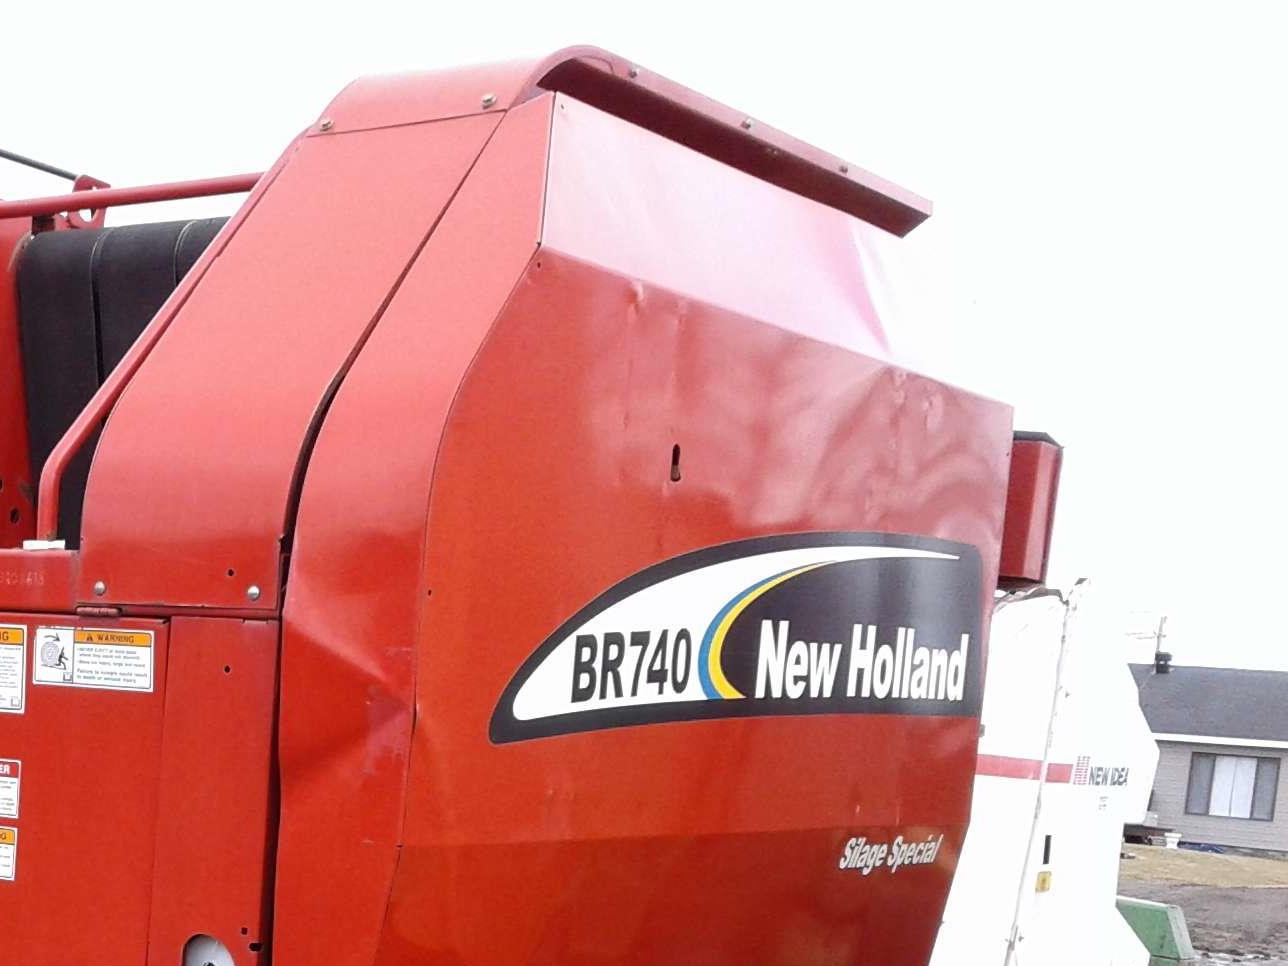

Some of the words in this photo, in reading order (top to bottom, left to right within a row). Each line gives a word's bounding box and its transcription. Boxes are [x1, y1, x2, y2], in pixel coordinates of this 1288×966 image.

[96, 634, 135, 643] WARNING
[570, 627, 692, 703] BR740
[754, 619, 843, 699] New
[846, 623, 970, 701] Holland
[1087, 766, 1108, 786] NEW
[1109, 767, 1130, 787] IDEA
[839, 837, 889, 876] Silage
[887, 833, 945, 874] Special
